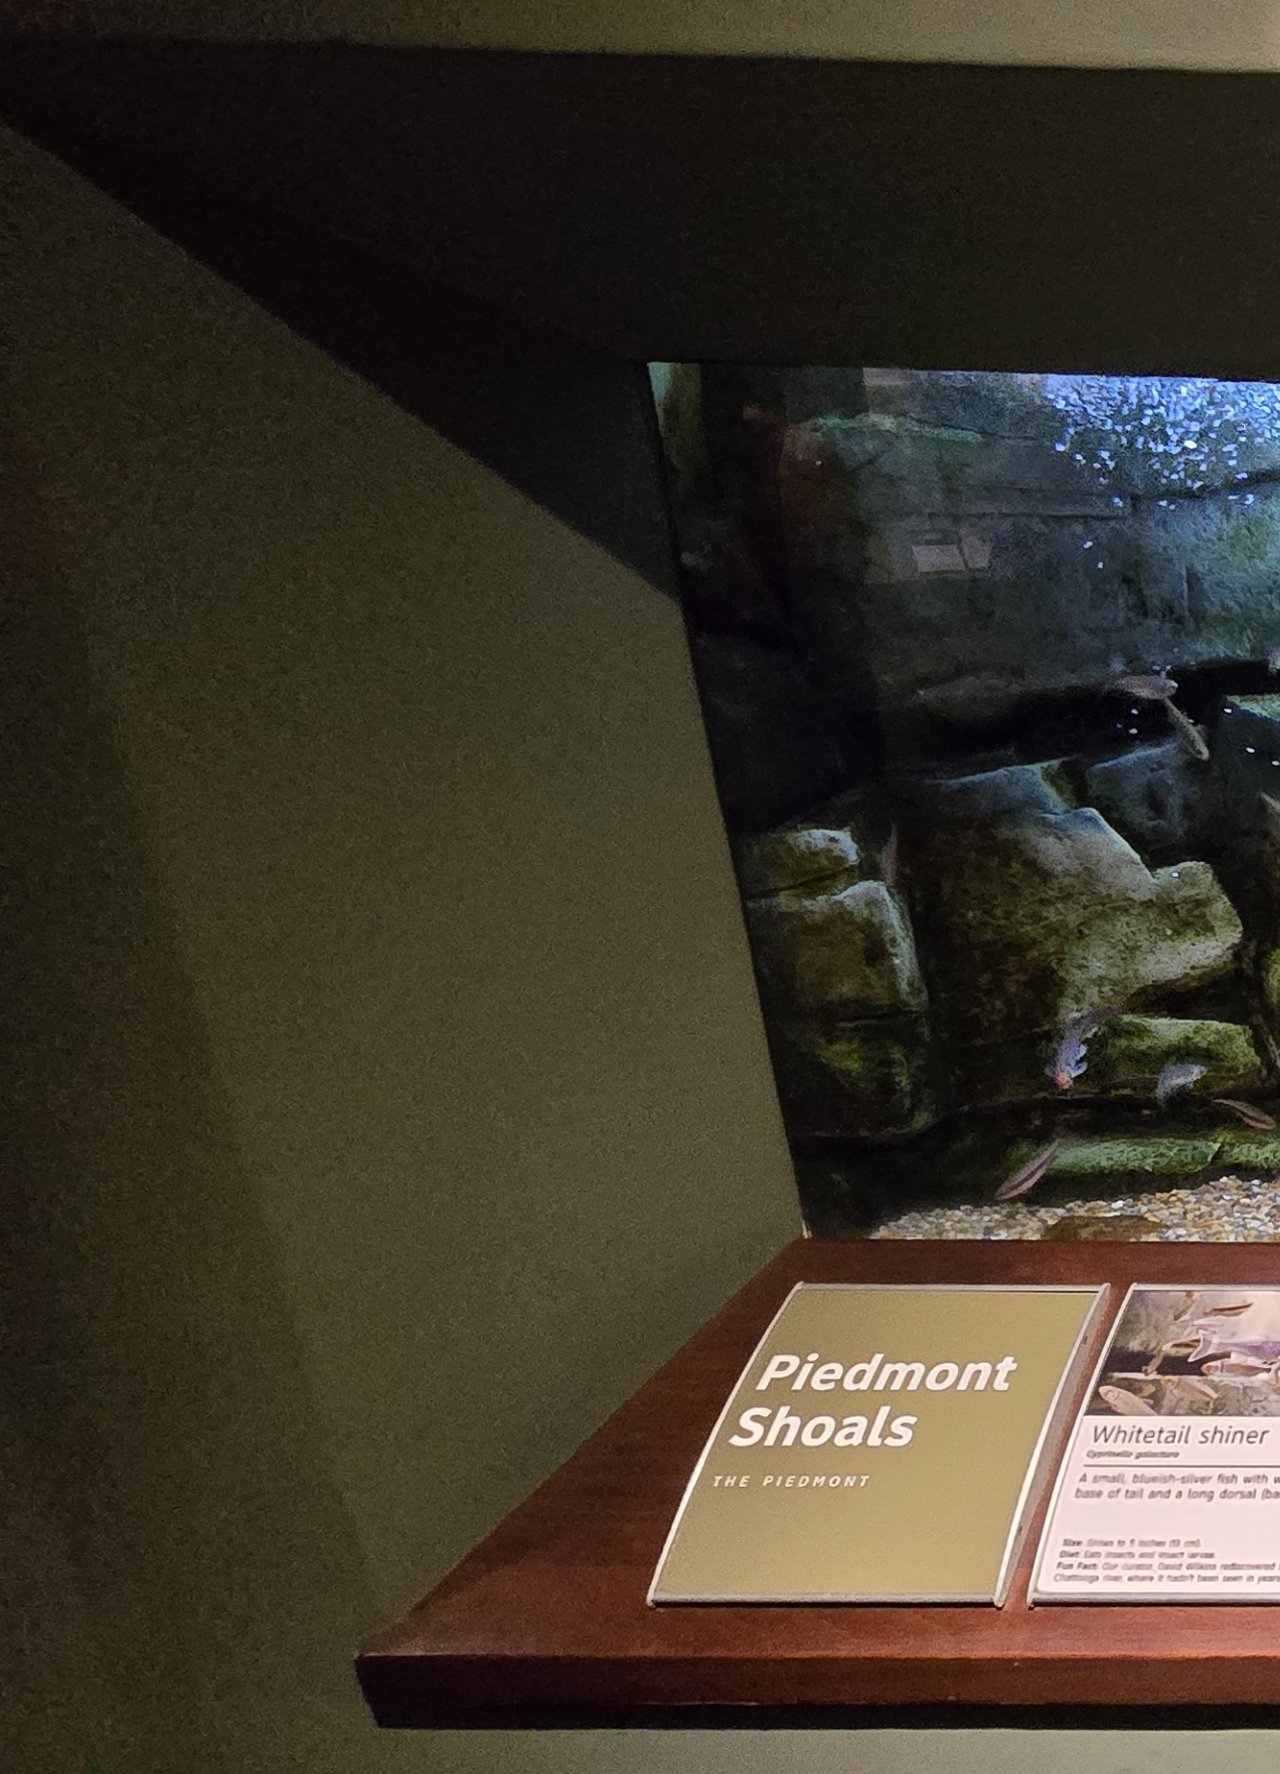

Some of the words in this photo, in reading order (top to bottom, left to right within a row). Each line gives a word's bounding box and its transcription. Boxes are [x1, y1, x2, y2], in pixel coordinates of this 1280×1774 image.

[755, 1352, 1018, 1392] Piedmont
[729, 1405, 917, 1447] Shoals
[1094, 1425, 1191, 1444] Whitetail
[1198, 1426, 1270, 1444] shiner
[712, 1475, 750, 1488] THE
[762, 1475, 870, 1488] PIEDMONT
[1079, 1473, 1087, 1482] A
[1132, 1473, 1213, 1484] blueish-silver
[1217, 1473, 1238, 1484] fish
[1243, 1474, 1268, 1484] with
[1074, 1487, 1103, 1498] base
[1107, 1488, 1122, 1499] of
[1124, 1488, 1144, 1499] tail
[1148, 1489, 1172, 1499] and
[1175, 1490, 1182, 1499] a
[1188, 1488, 1215, 1502] long
[1219, 1488, 1257, 1499] dorsal
